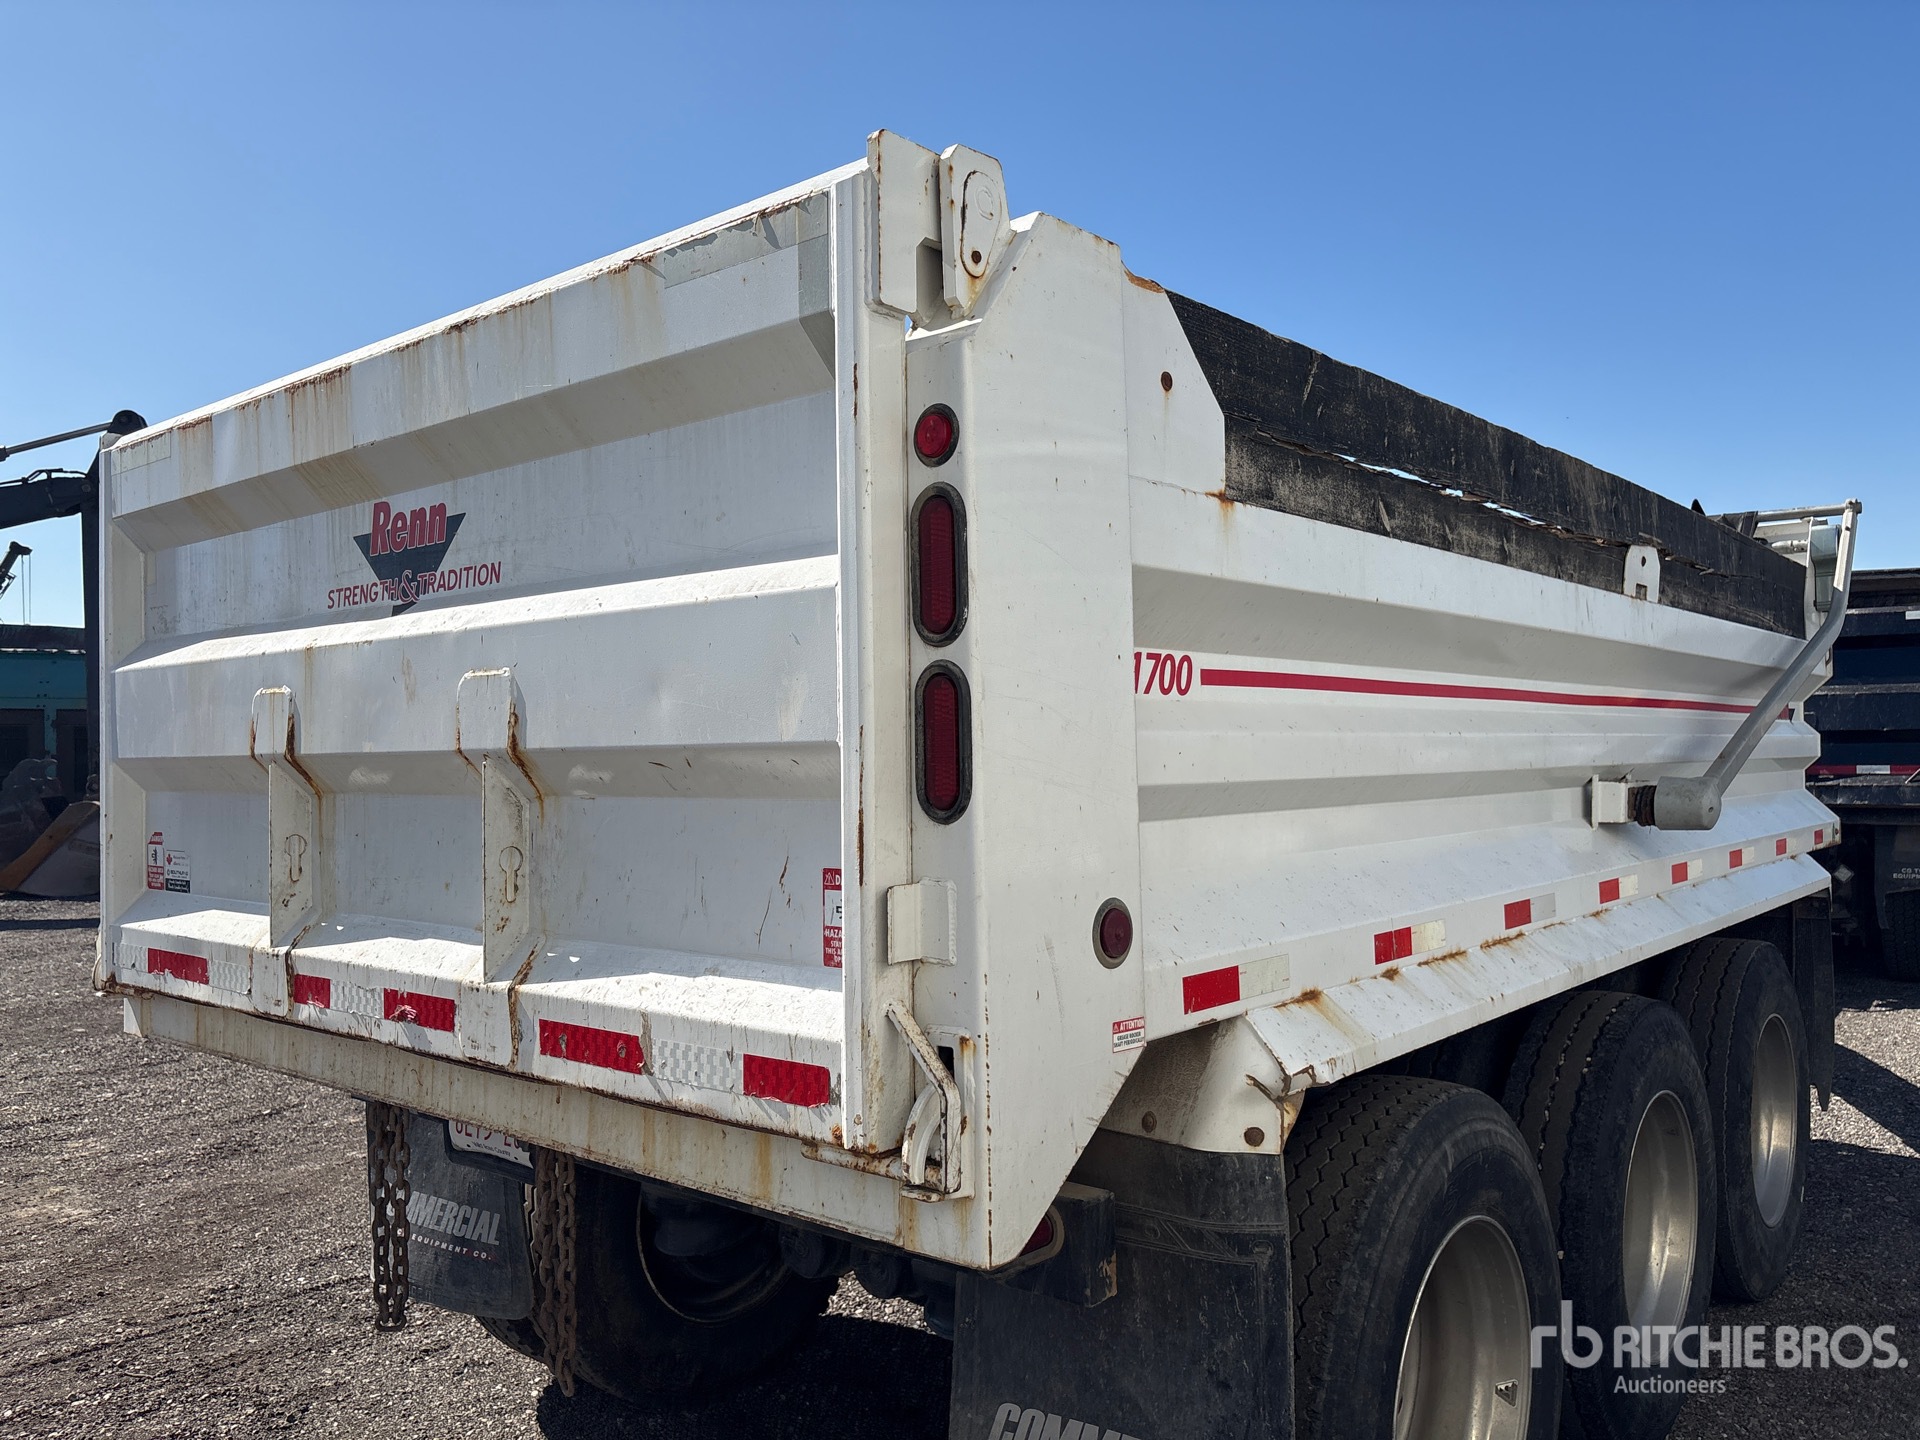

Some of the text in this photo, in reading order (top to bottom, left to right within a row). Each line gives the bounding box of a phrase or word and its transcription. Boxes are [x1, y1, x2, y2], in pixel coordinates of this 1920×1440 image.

[370, 500, 446, 556] Renn
[327, 561, 501, 610] STRENGTH & TRADITION
[1134, 651, 1193, 696] 1700
[1119, 1018, 1144, 1031] ATTENTION
[411, 1233, 492, 1261] EQUIPMENT CO.
